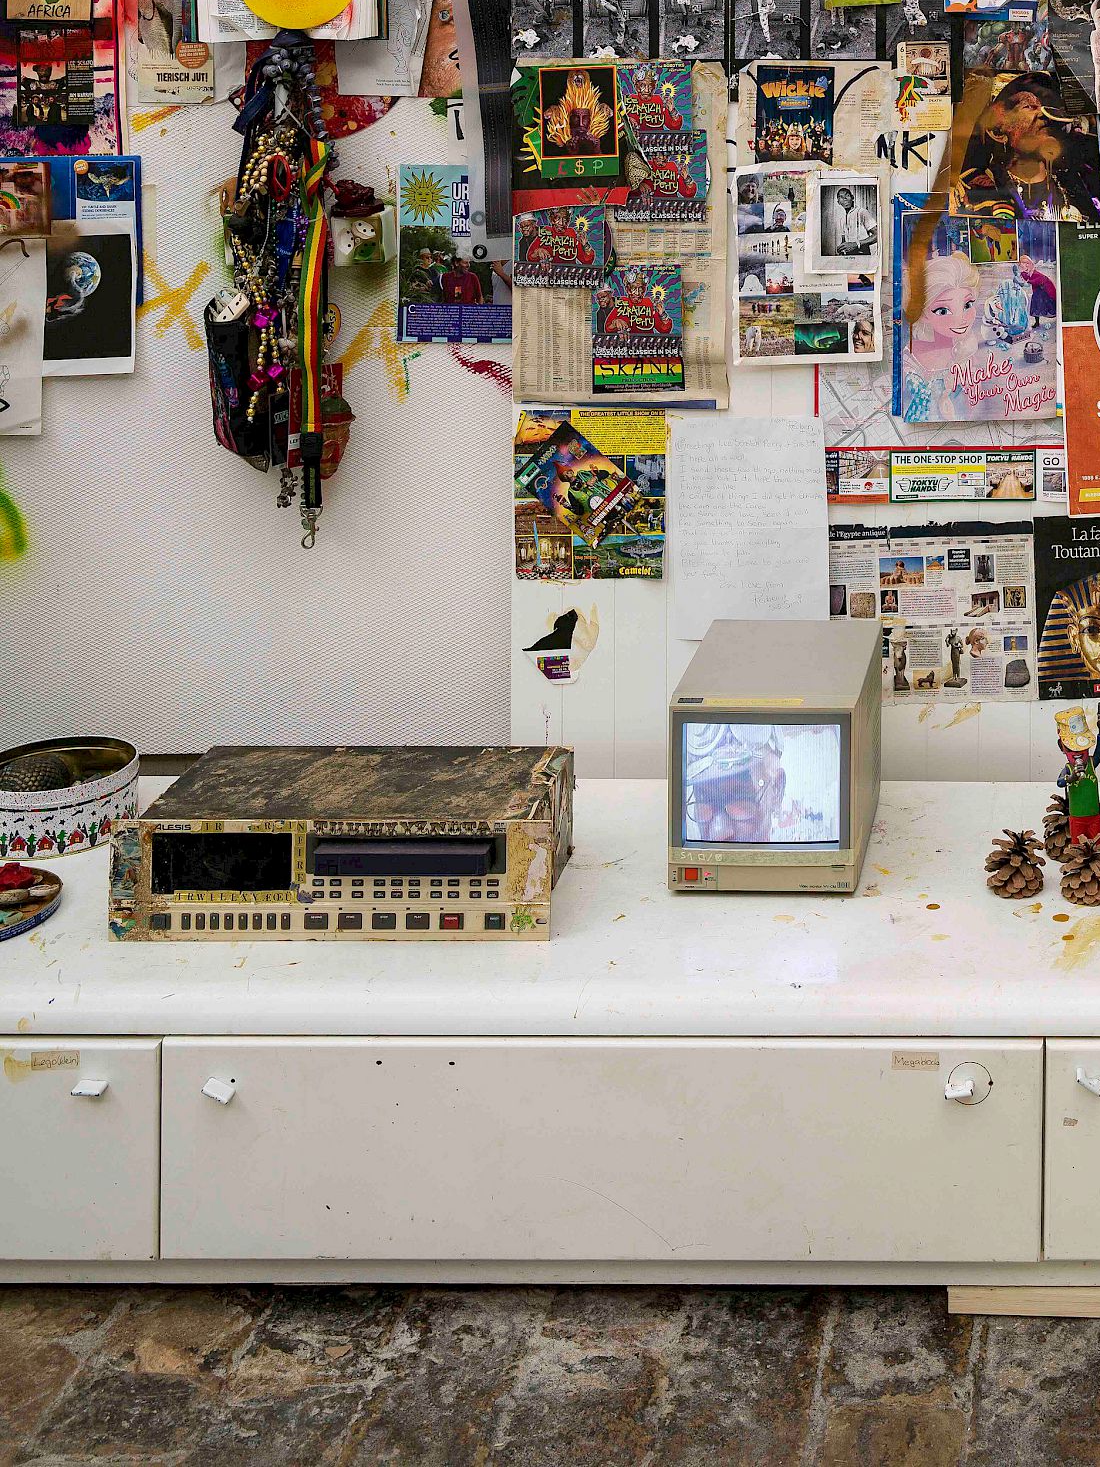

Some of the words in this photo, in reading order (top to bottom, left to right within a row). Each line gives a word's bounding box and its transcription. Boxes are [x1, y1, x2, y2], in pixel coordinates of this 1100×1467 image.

[28, 3, 71, 19] AFRICA
[157, 73, 189, 82] TIERISCH
[192, 73, 208, 82] JUT!
[760, 79, 828, 99] Wickie
[626, 104, 661, 114] SCRATCH
[617, 306, 651, 316] SCRATCH
[950, 352, 1013, 390] Make
[964, 384, 1003, 405] Your
[1005, 372, 1040, 391] Own
[1003, 386, 1056, 416] Magic
[894, 455, 912, 464] THE
[913, 455, 956, 464] ONE-STOP
[958, 455, 983, 464] SHOP
[1042, 457, 1060, 466] GO
[861, 529, 886, 537] antique
[1072, 527, 1088, 542] La
